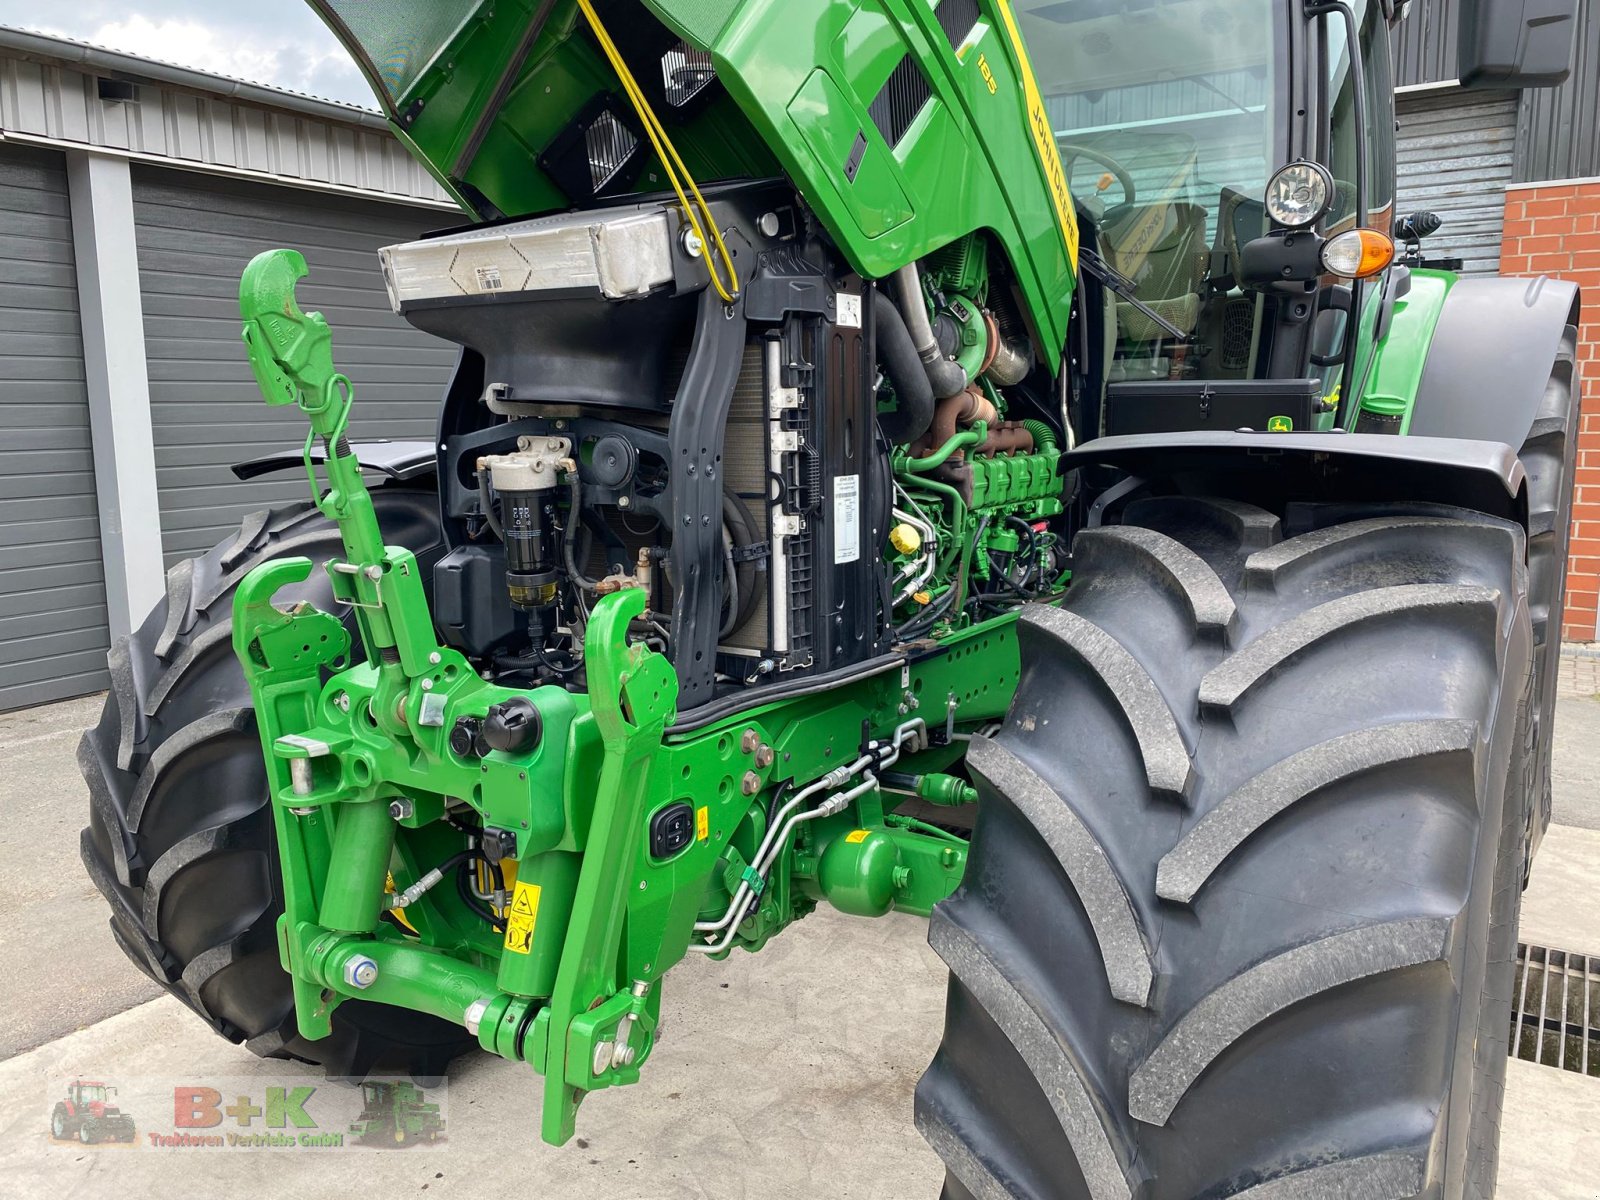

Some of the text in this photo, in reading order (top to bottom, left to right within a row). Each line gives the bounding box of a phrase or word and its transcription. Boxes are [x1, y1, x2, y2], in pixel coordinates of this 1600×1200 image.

[976, 53, 998, 95] 185
[1033, 105, 1075, 247] JOHN DEERE
